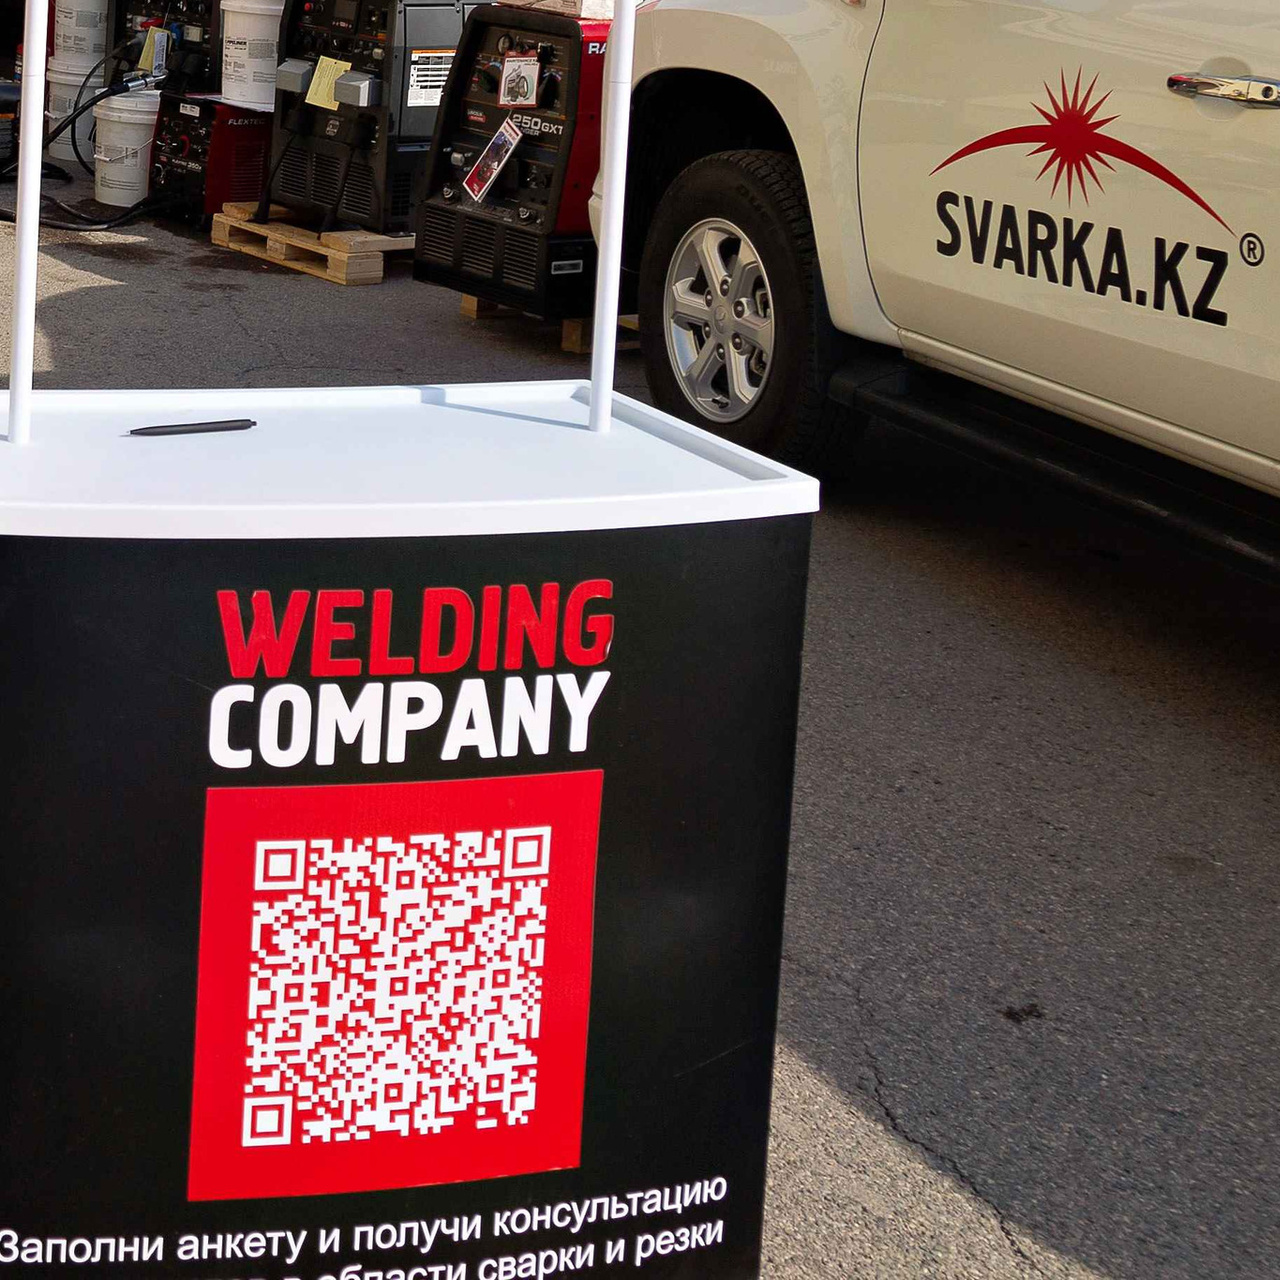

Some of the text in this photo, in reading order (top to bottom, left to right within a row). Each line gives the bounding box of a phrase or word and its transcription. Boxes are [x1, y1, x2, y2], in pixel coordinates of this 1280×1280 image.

[227, 118, 266, 126] FLEXTEC
[936, 190, 1229, 327] SVARKA.KZ
[217, 578, 614, 679] WELDING
[208, 670, 611, 769] COMPANY
[177, 1228, 308, 1265] анкету
[319, 1227, 340, 1255] и
[353, 1214, 482, 1254] получи
[493, 1176, 727, 1237] консультацию
[478, 1243, 595, 1280] сварки
[606, 1237, 626, 1265] и
[635, 1219, 724, 1266] резки
